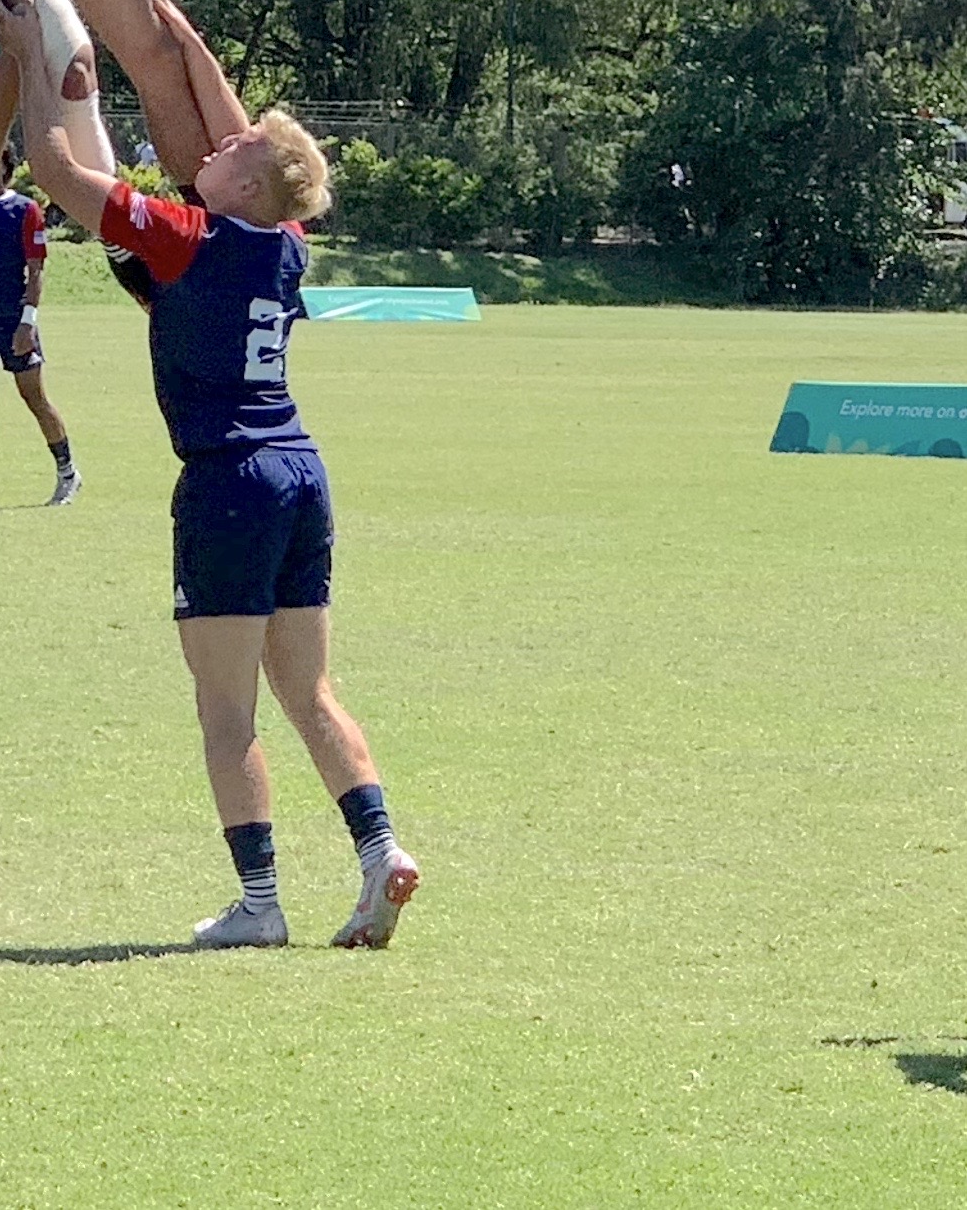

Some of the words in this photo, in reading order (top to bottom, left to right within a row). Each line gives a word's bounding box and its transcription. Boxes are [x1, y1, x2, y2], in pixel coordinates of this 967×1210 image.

[839, 399, 893, 419] Explore
[896, 406, 933, 419] more
[937, 406, 955, 419] on
